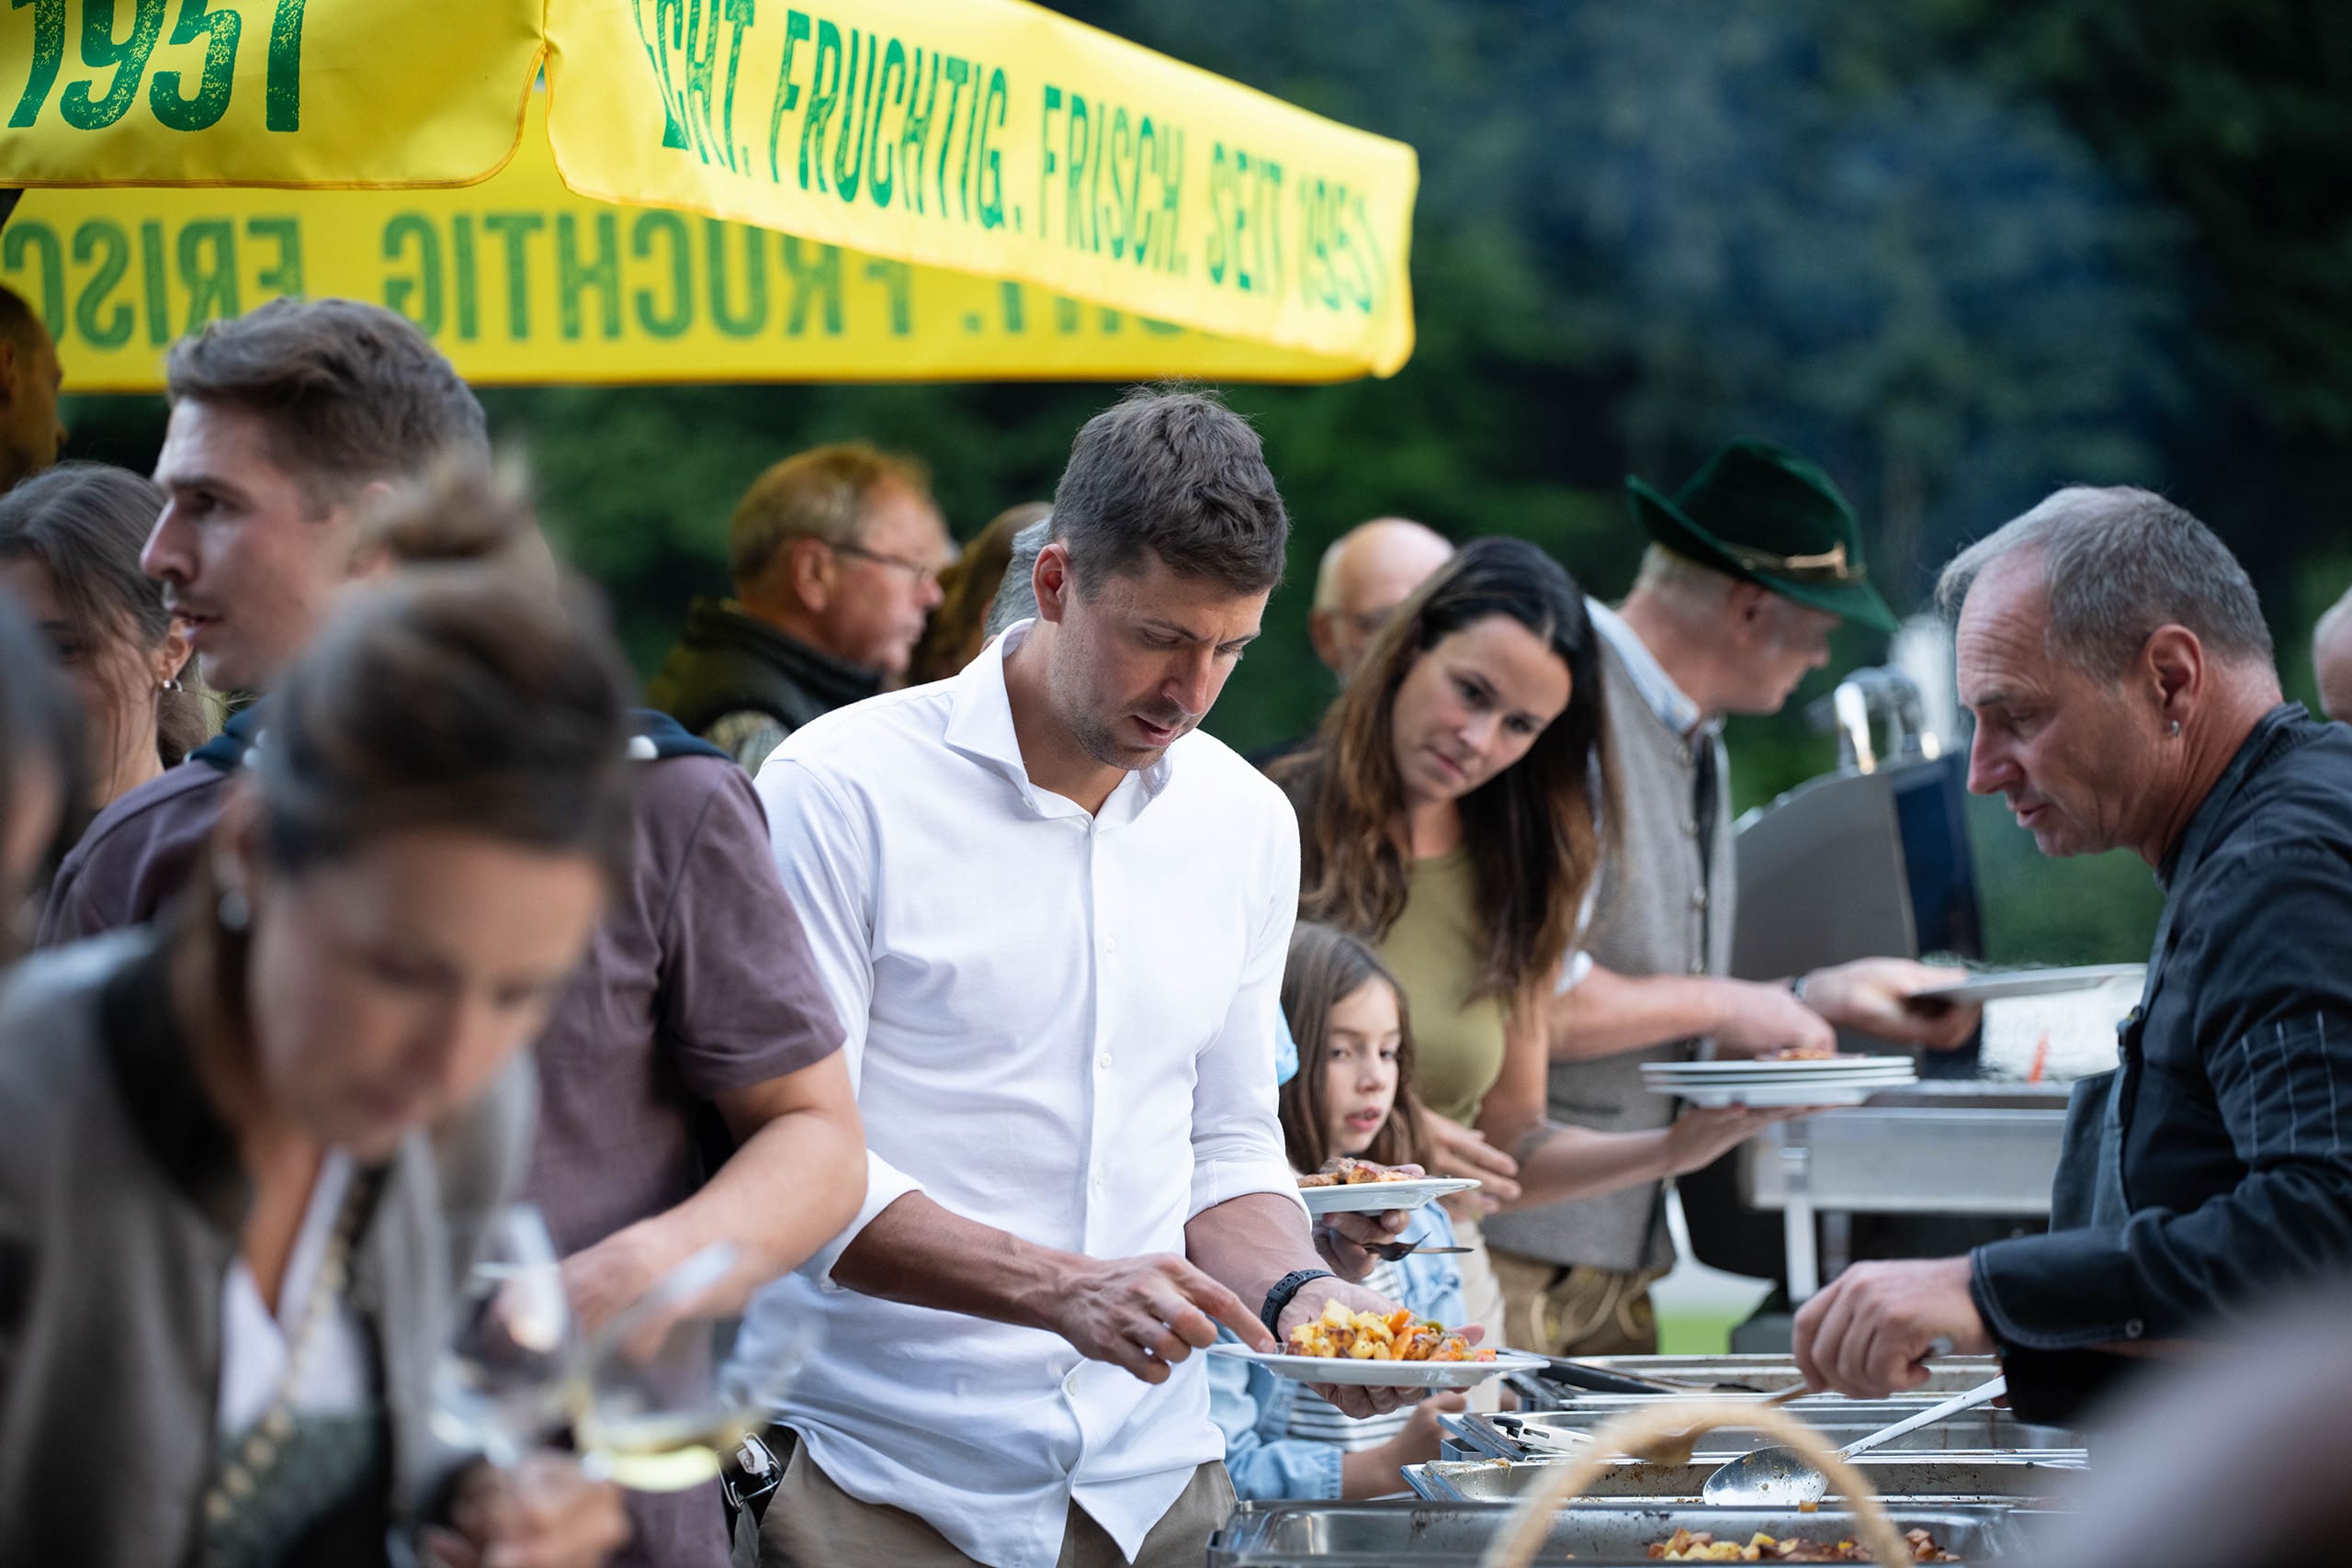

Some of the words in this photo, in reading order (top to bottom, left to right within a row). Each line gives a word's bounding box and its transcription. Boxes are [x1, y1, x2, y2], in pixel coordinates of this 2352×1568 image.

[7, 0, 306, 132] 1951
[769, 8, 1022, 232] FRUCHTIG.
[1039, 81, 1189, 275] FRISCH.
[1205, 141, 1285, 298] SEIT
